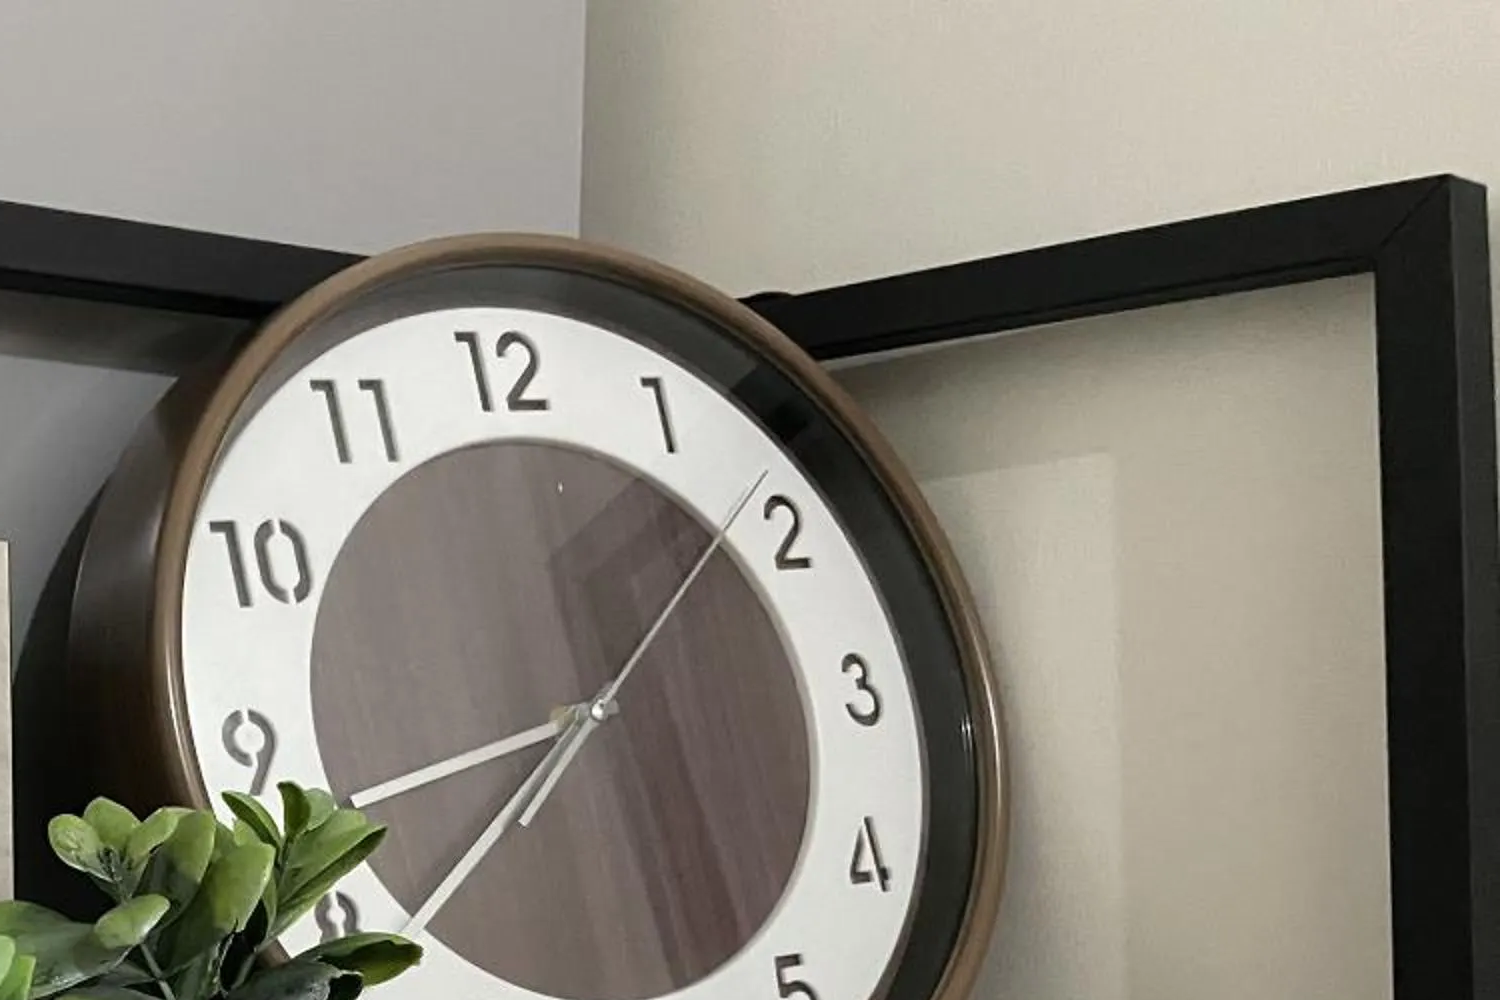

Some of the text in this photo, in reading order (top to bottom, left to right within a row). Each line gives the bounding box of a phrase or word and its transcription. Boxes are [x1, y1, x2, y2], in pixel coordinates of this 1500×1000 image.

[454, 331, 549, 412] 12
[309, 378, 401, 464] 11
[640, 376, 678, 454] 1
[209, 519, 312, 607] 10
[763, 494, 813, 570] 2
[842, 653, 882, 726] 3
[221, 708, 277, 797] 9
[850, 816, 891, 892] 4
